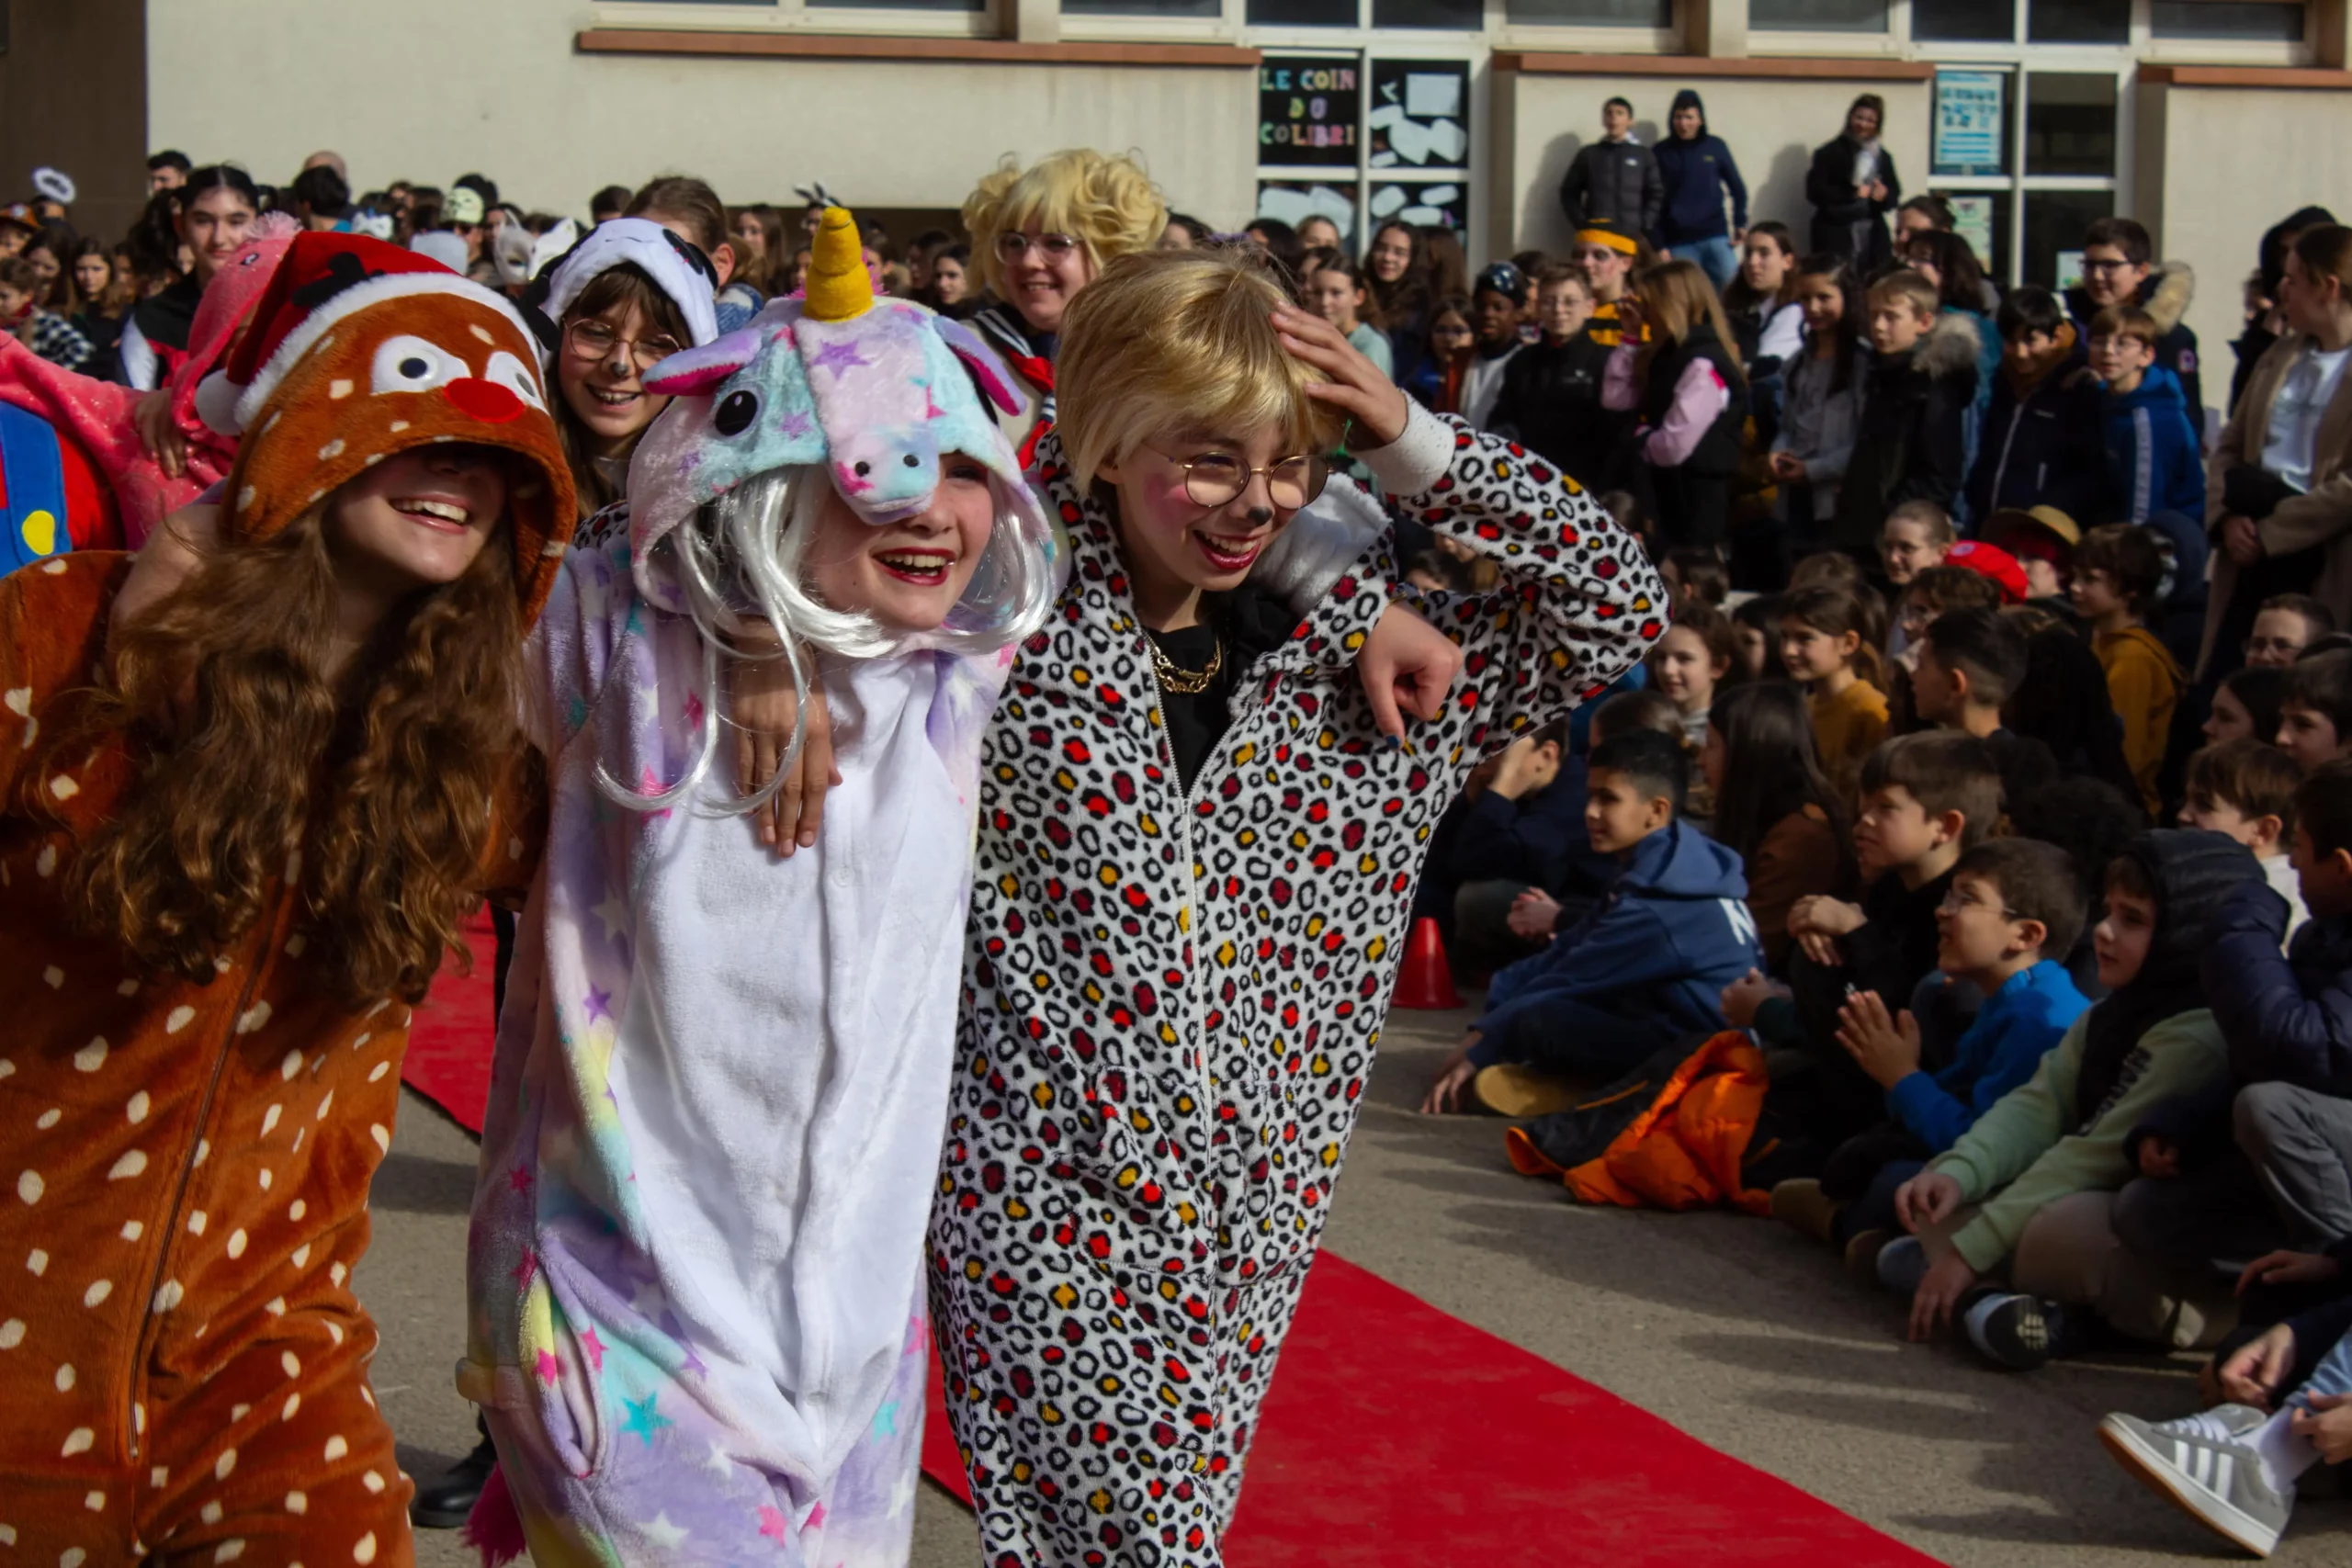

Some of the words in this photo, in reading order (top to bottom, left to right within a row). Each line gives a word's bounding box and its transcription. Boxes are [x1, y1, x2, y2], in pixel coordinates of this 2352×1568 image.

[1260, 67, 1291, 91] LE
[1299, 68, 1355, 91] COIN
[1260, 121, 1355, 148] COLIBRI
